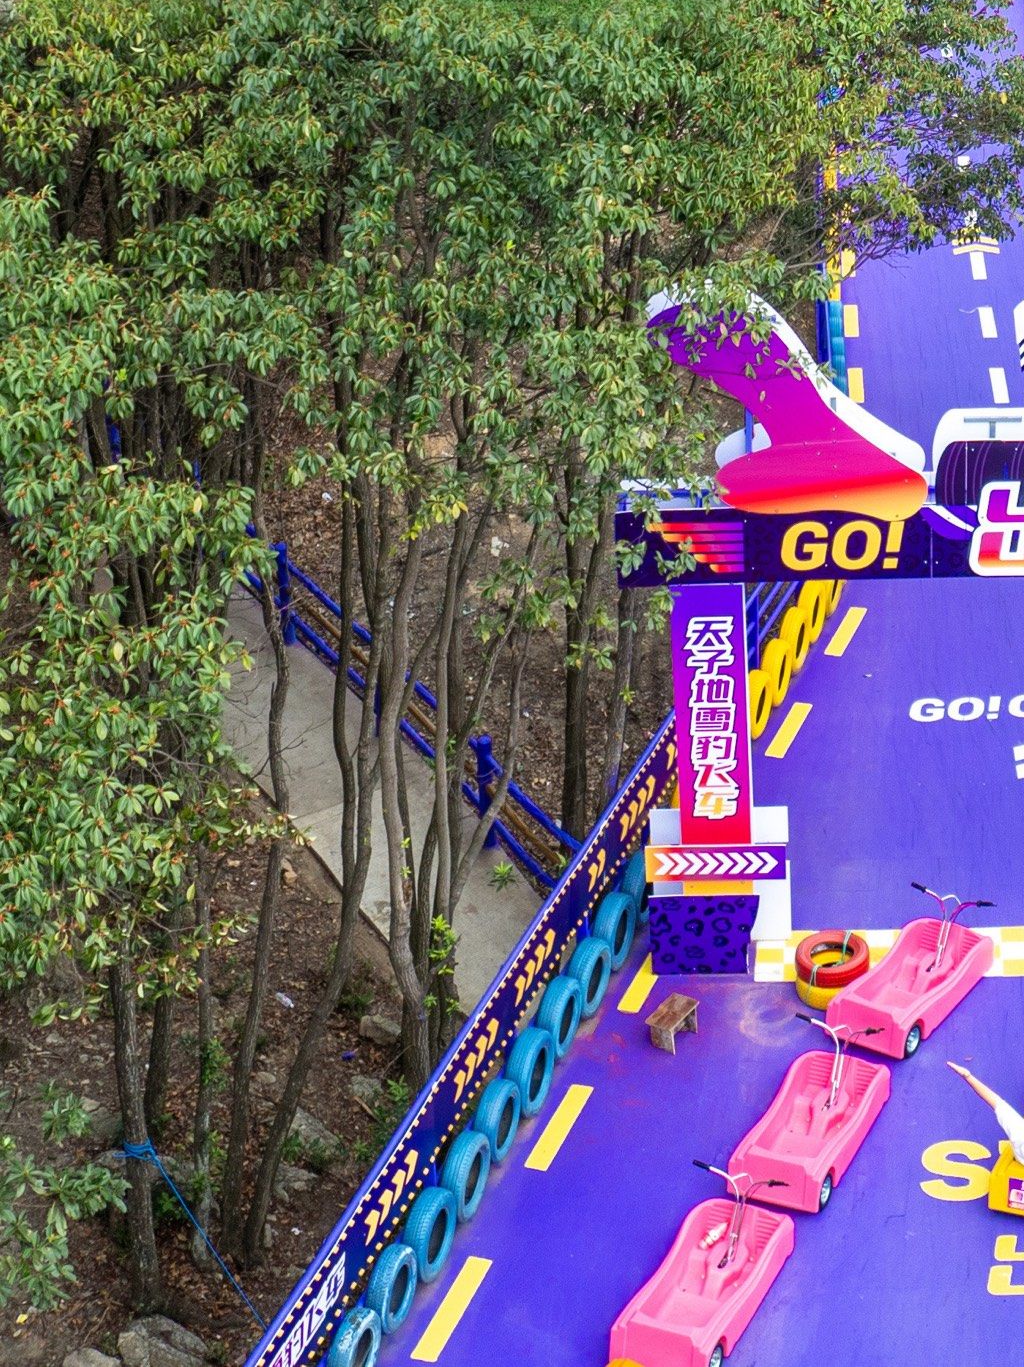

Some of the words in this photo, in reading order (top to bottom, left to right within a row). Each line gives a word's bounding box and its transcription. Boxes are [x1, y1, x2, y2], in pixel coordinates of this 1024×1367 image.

[781, 520, 905, 571] GO!
[686, 617, 738, 818] 天子地雪豹飞车
